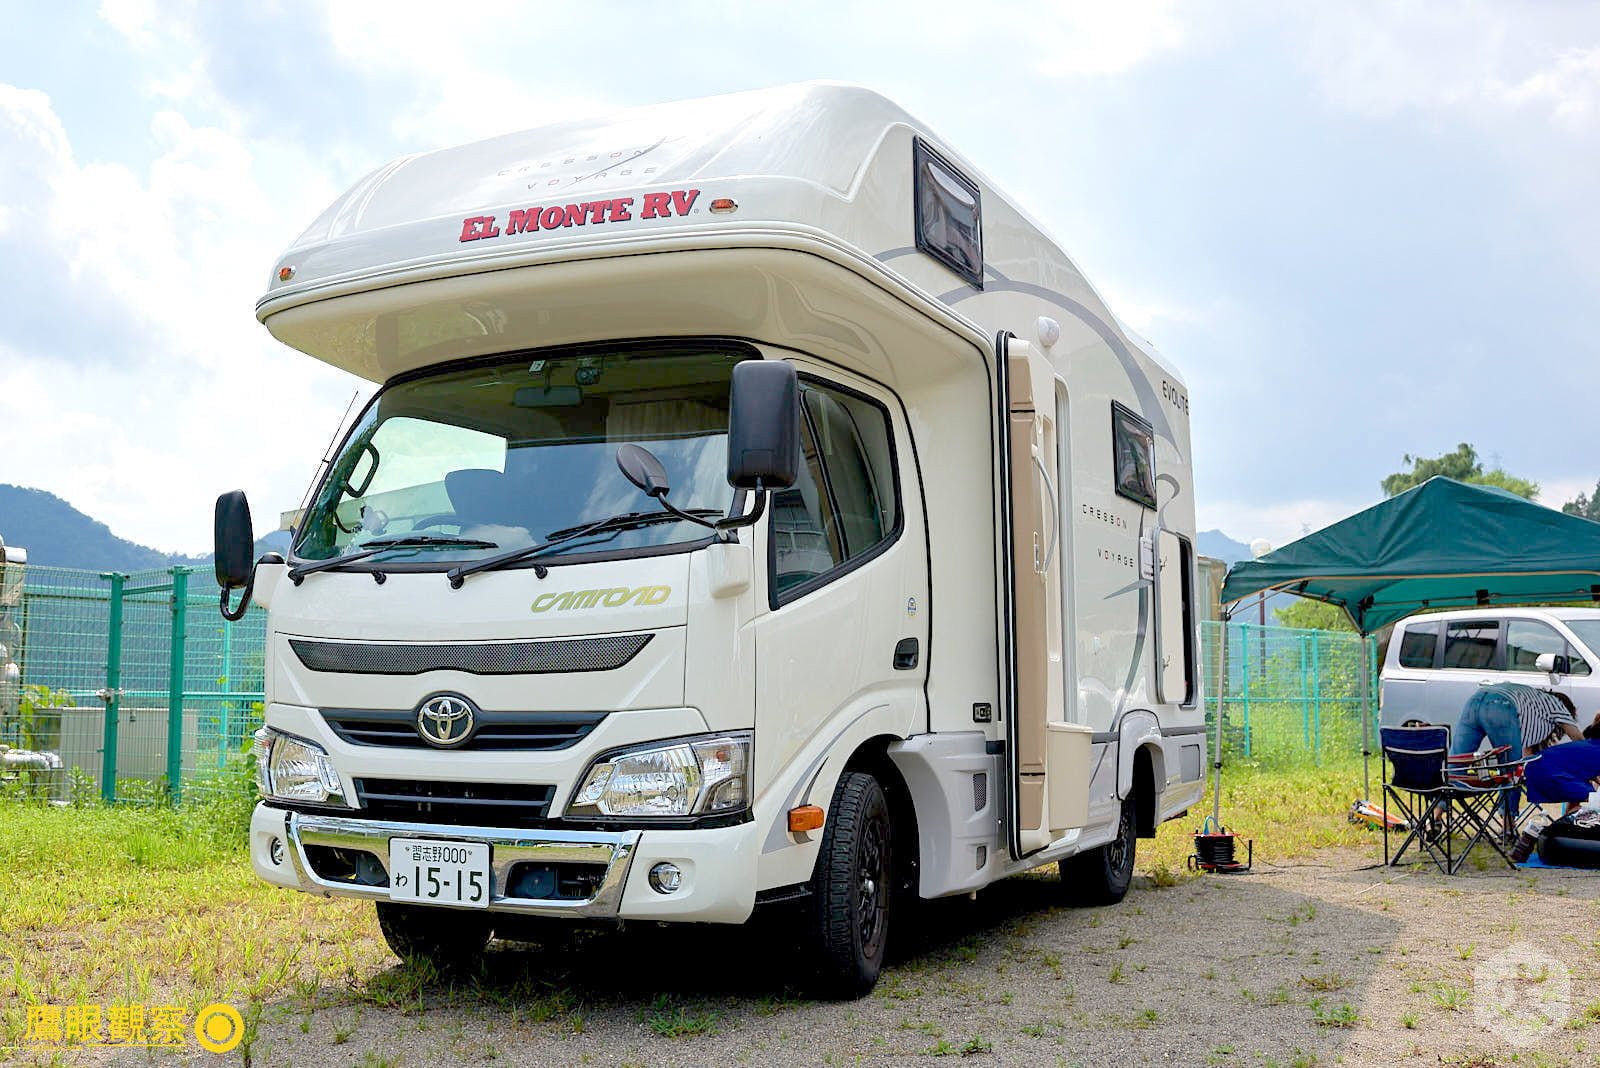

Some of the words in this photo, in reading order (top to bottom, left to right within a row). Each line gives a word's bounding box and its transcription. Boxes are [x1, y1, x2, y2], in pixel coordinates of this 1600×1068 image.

[526, 167, 656, 190] VOYAGE
[459, 214, 500, 243] EL
[505, 197, 634, 235] MONTE
[640, 189, 701, 219] RV
[1082, 503, 1127, 529] CRESSON
[1097, 547, 1134, 568] VOYAGE
[412, 845, 467, 864] 習志野000
[395, 872, 408, 887] わ
[415, 866, 483, 902] 15-15
